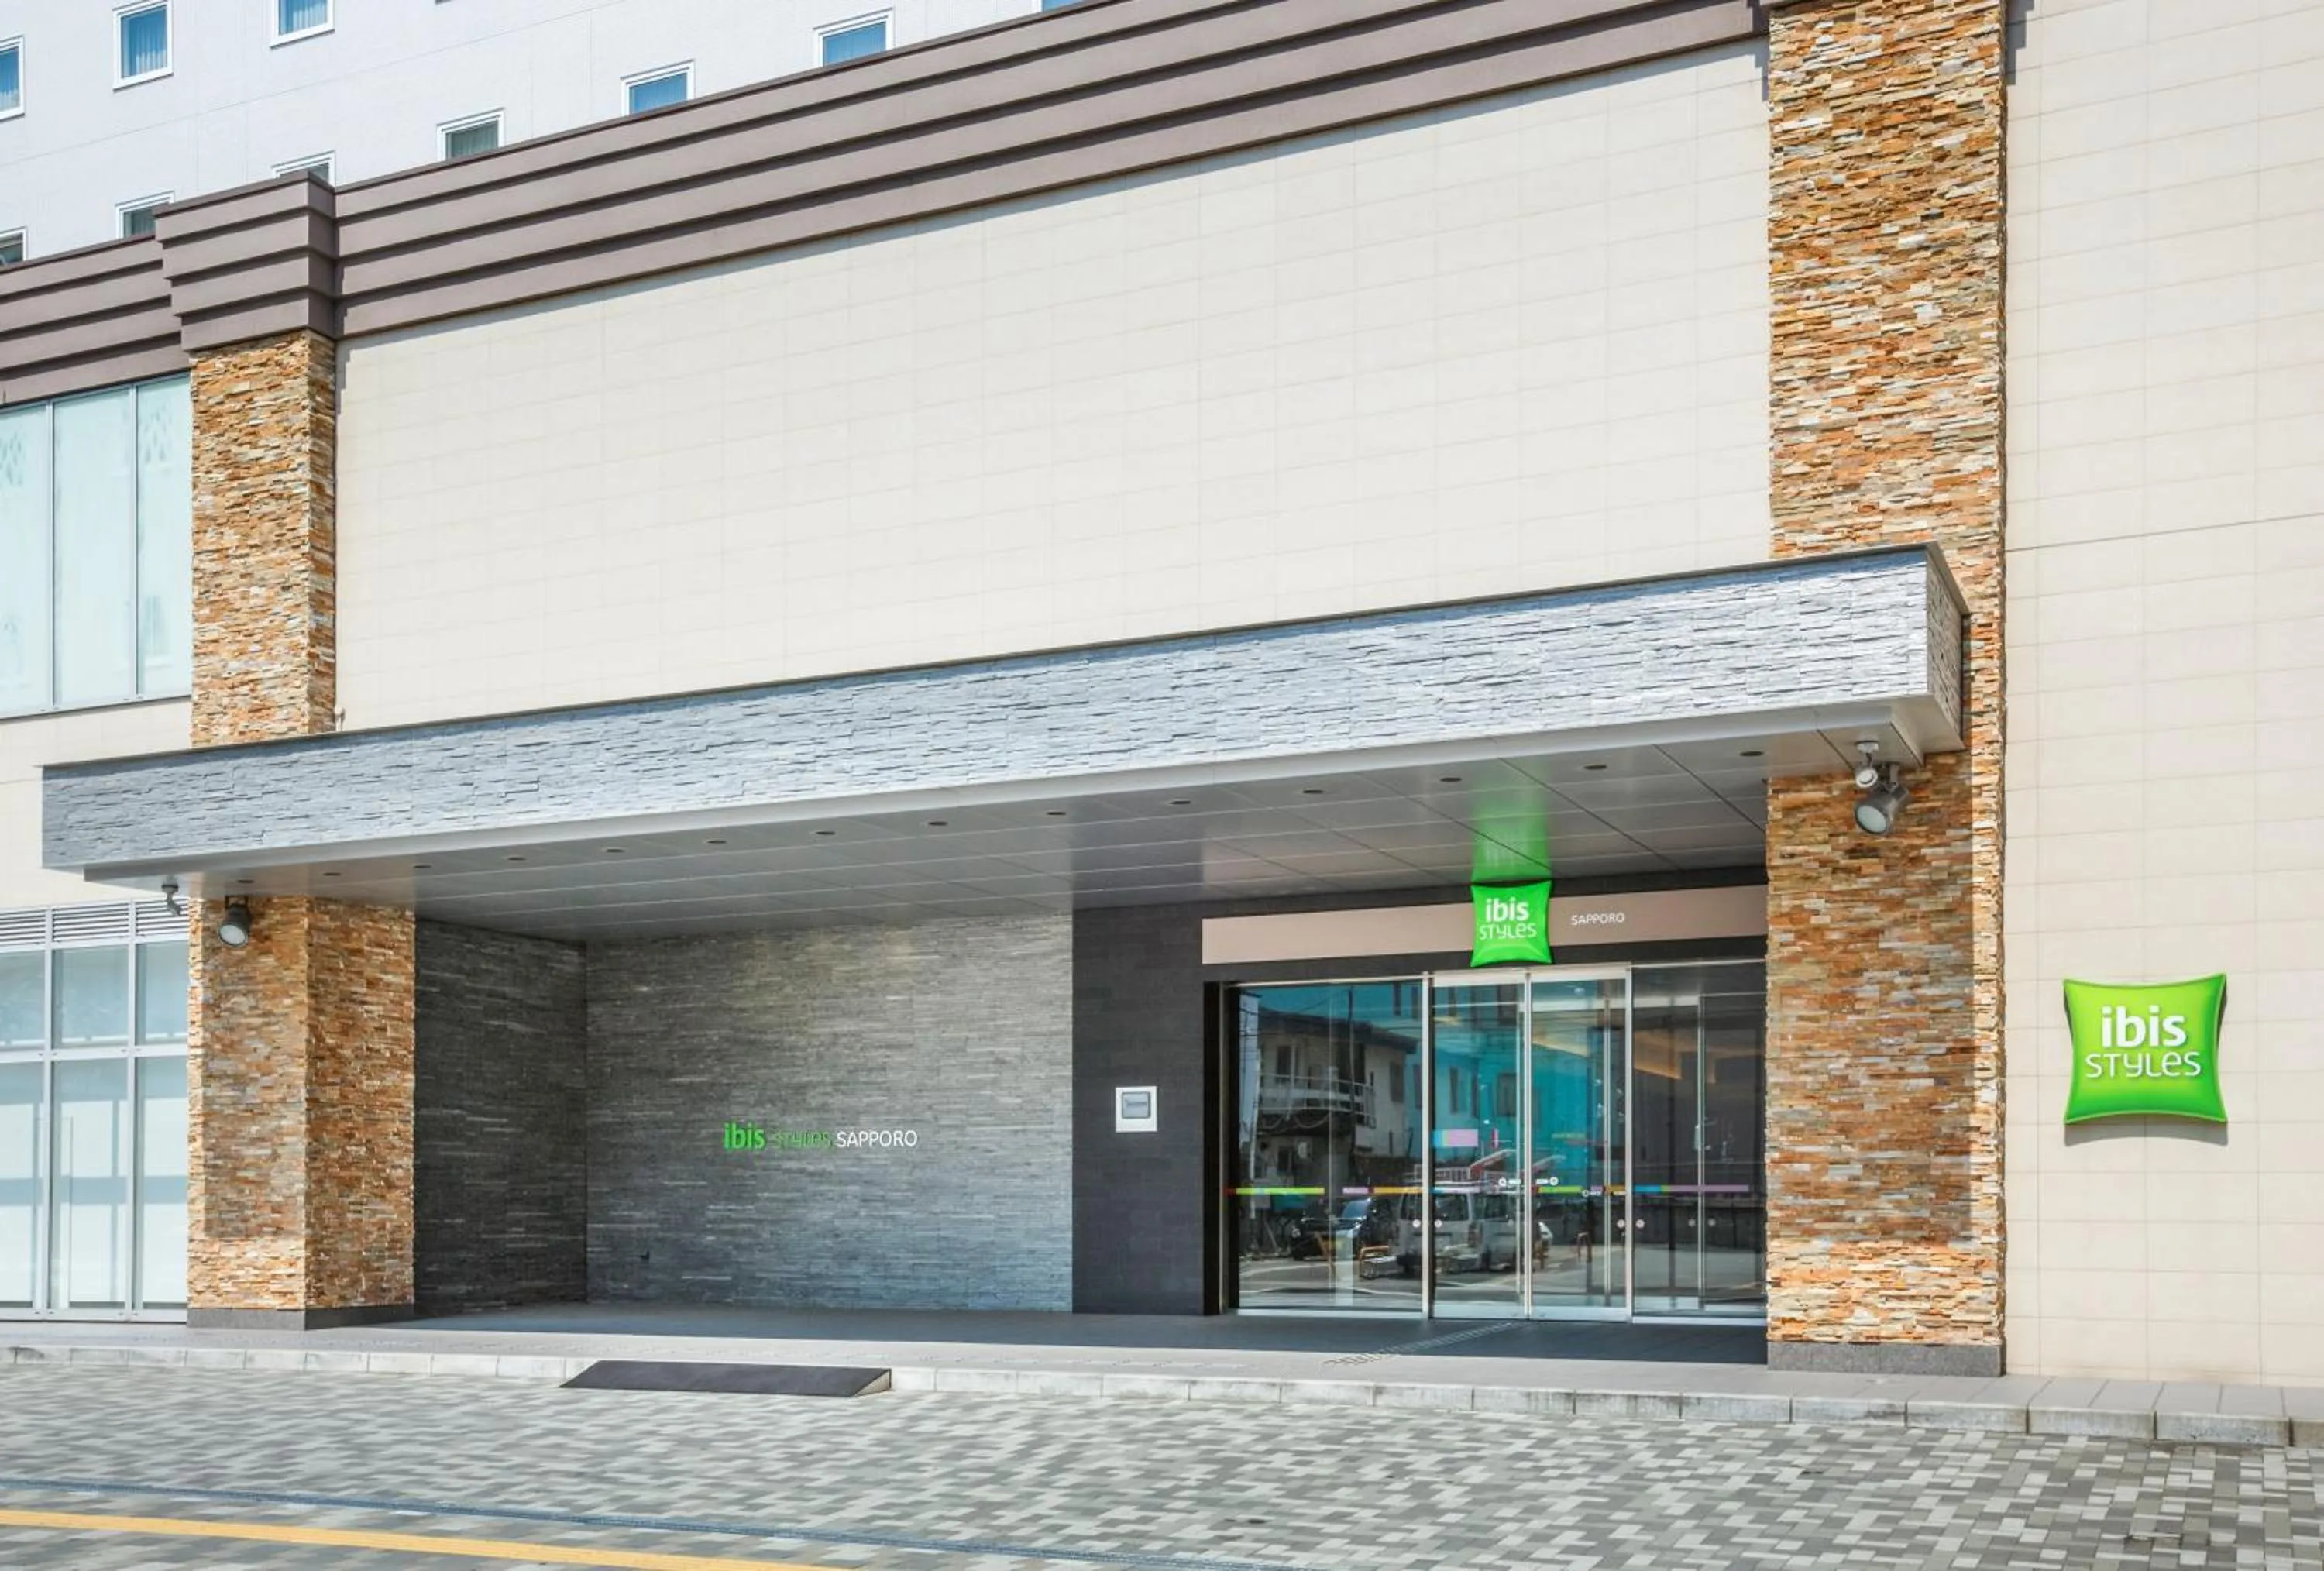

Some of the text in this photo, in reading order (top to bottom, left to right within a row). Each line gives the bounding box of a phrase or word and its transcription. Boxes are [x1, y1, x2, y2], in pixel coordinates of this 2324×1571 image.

[1485, 897, 1529, 923] ibis
[1570, 912, 1625, 926] SAPPORO
[2101, 1005, 2187, 1048] ibis
[724, 1122, 765, 1150] ibis
[836, 1130, 918, 1148] SAPPORO
